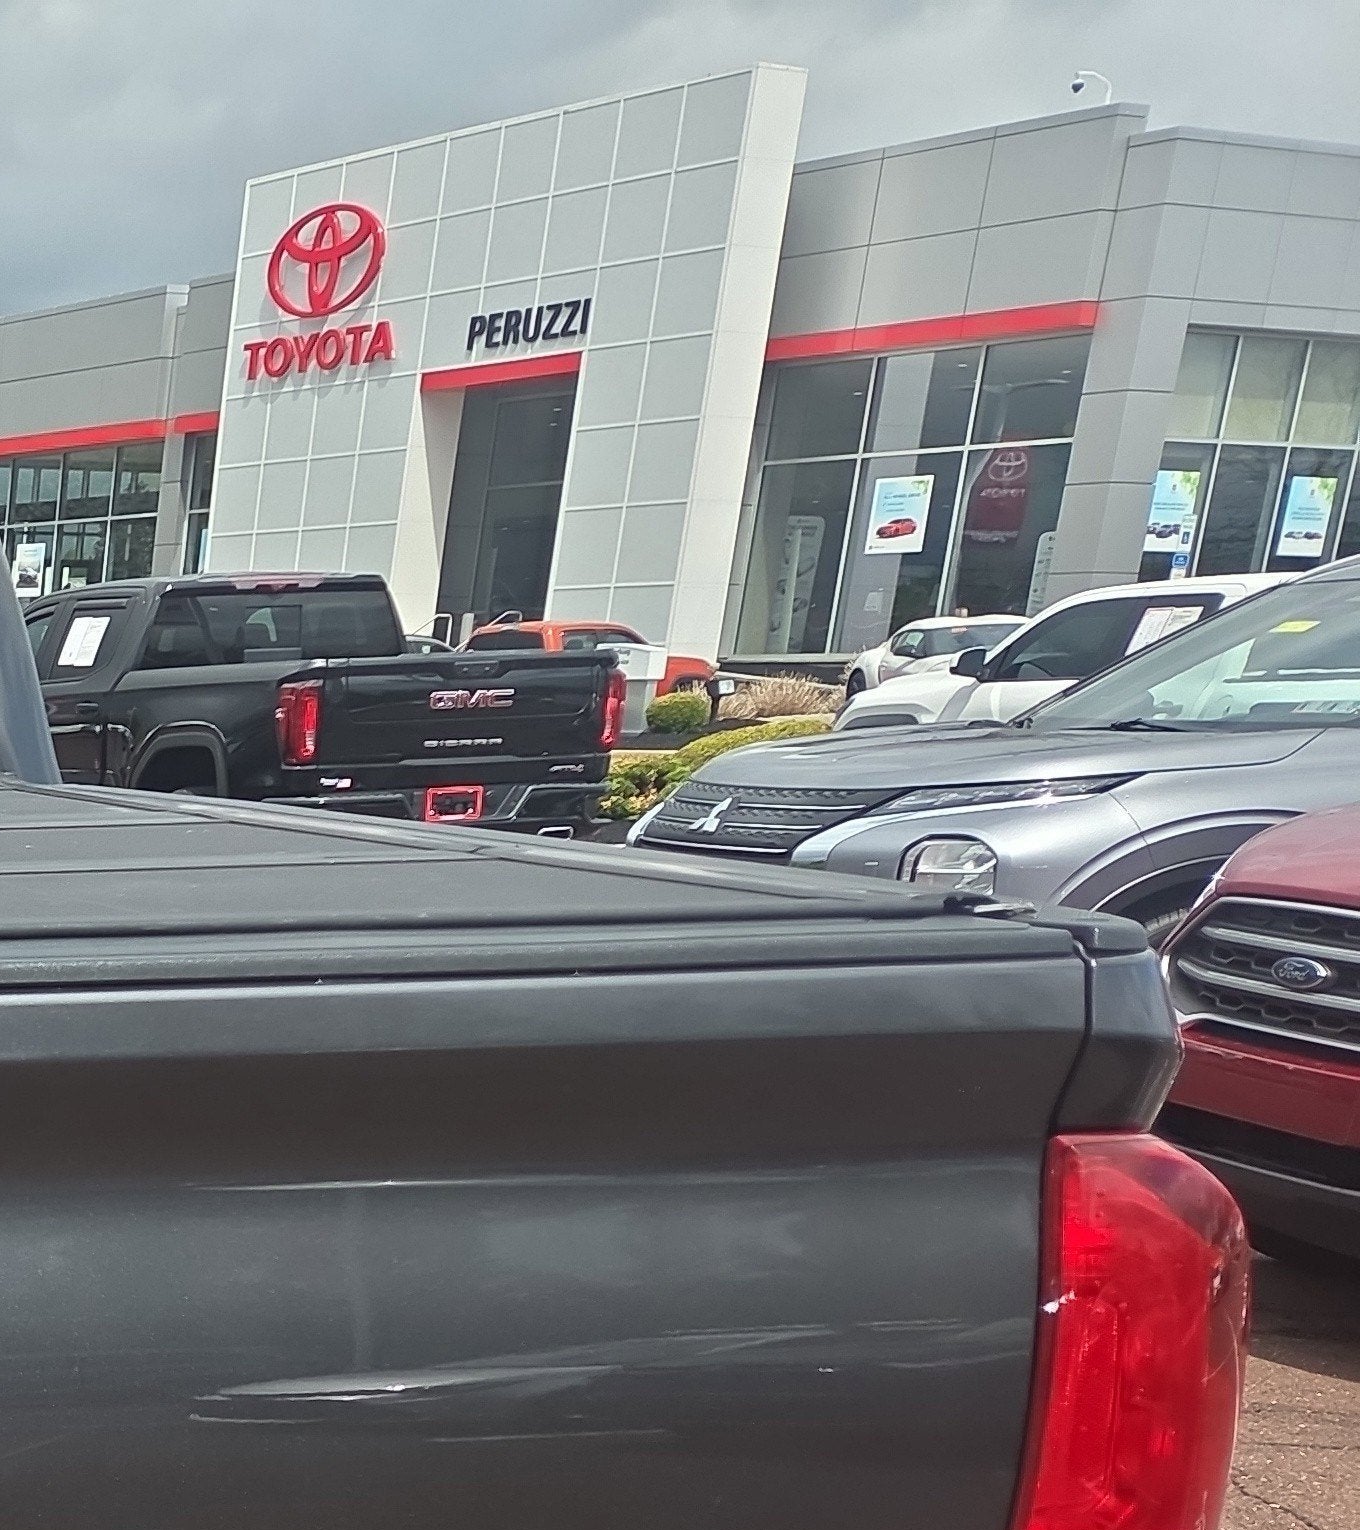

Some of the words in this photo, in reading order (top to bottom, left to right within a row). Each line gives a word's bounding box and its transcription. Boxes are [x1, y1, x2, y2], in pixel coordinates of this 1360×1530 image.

[242, 321, 394, 381] TOYOTA
[466, 298, 592, 351] PERUZZI
[429, 689, 515, 710] GMC
